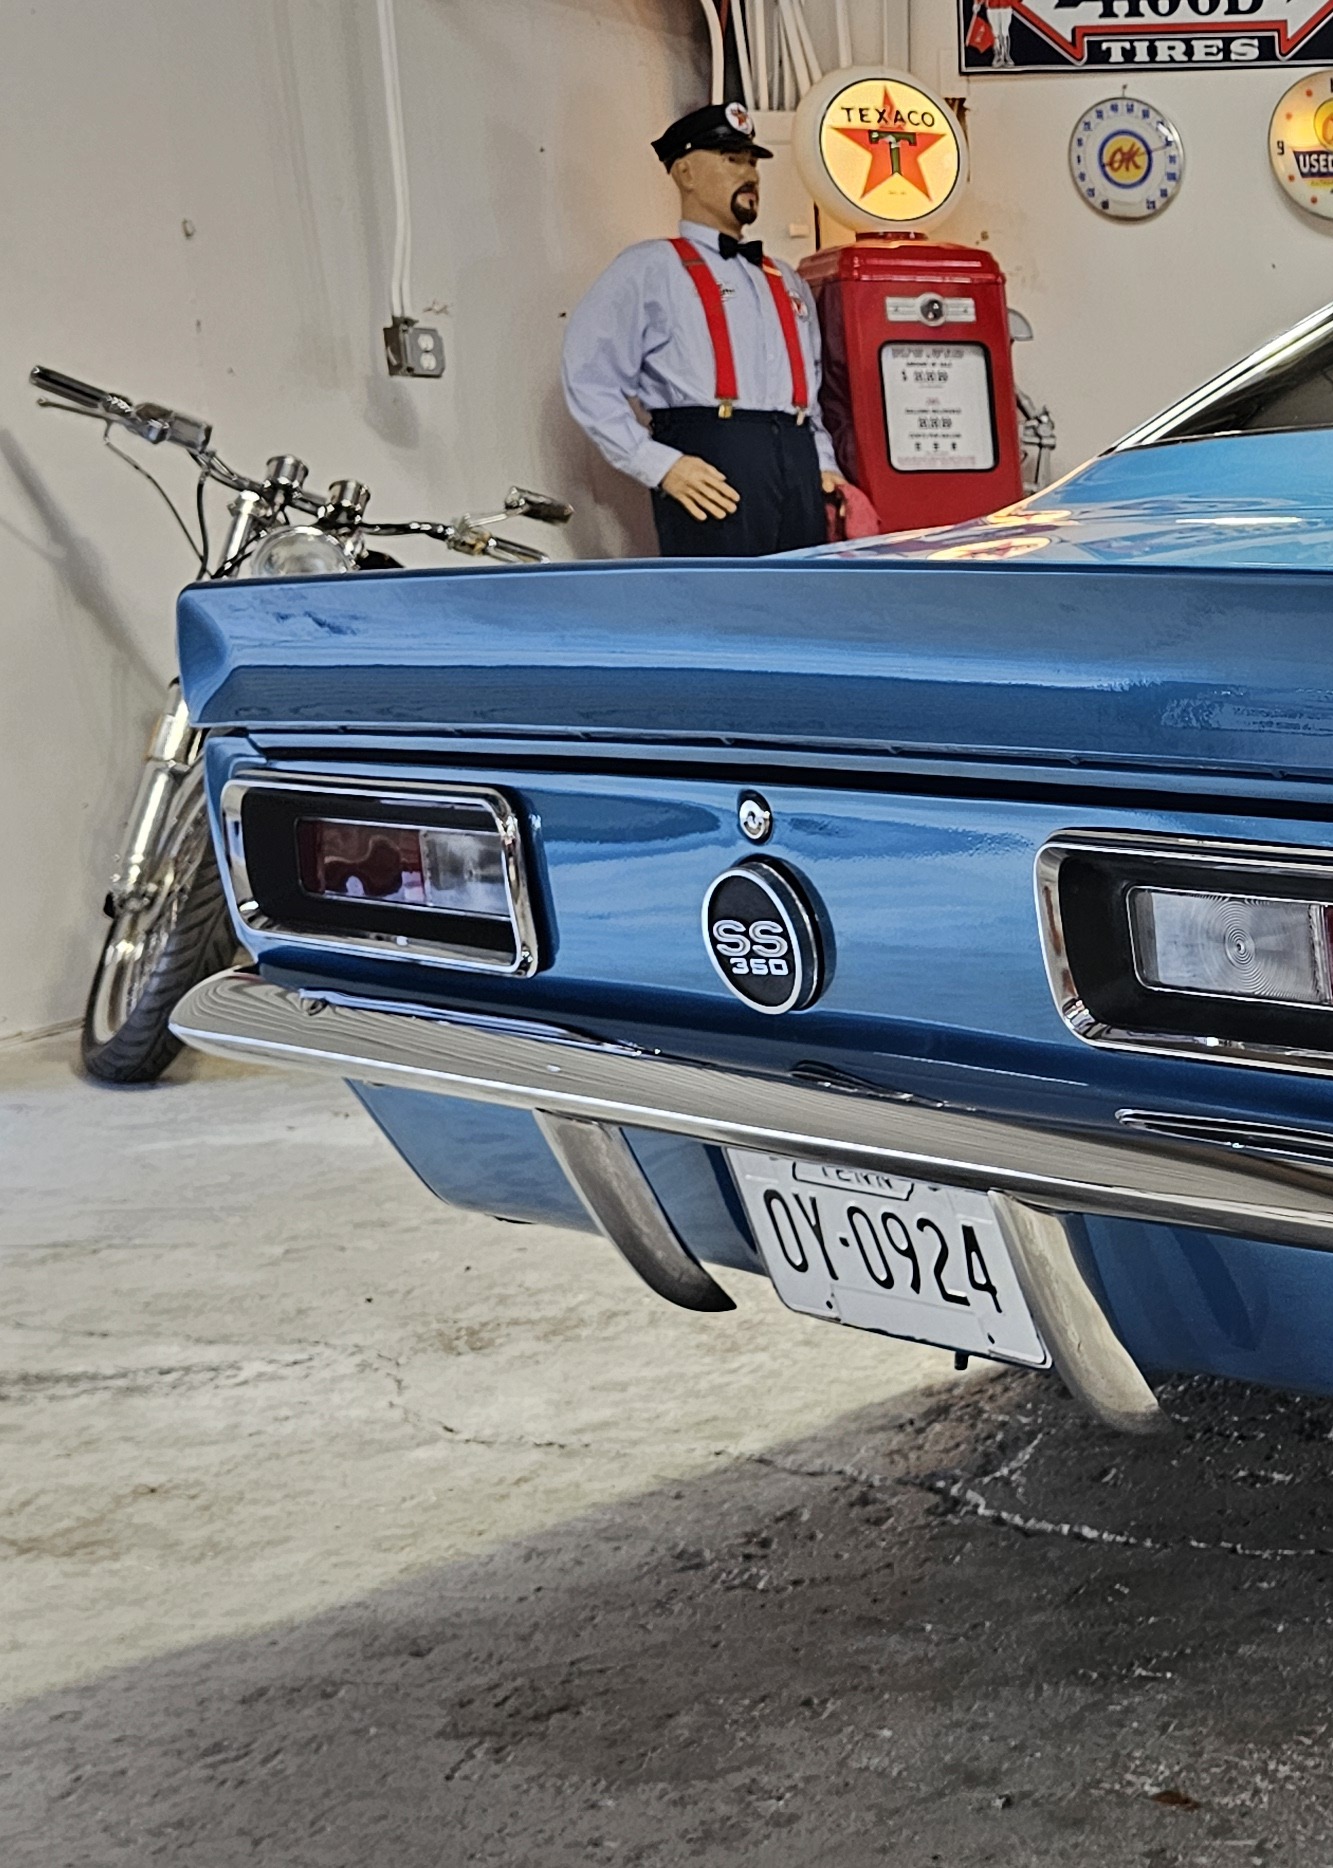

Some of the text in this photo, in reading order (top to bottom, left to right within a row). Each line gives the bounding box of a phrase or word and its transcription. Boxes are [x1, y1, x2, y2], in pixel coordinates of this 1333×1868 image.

[1101, 38, 1260, 63] TIRES
[841, 106, 935, 128] TEXACO
[1109, 142, 1142, 172] OK
[1277, 140, 1284, 155] 9
[713, 919, 788, 958] SS
[729, 957, 789, 976] 350
